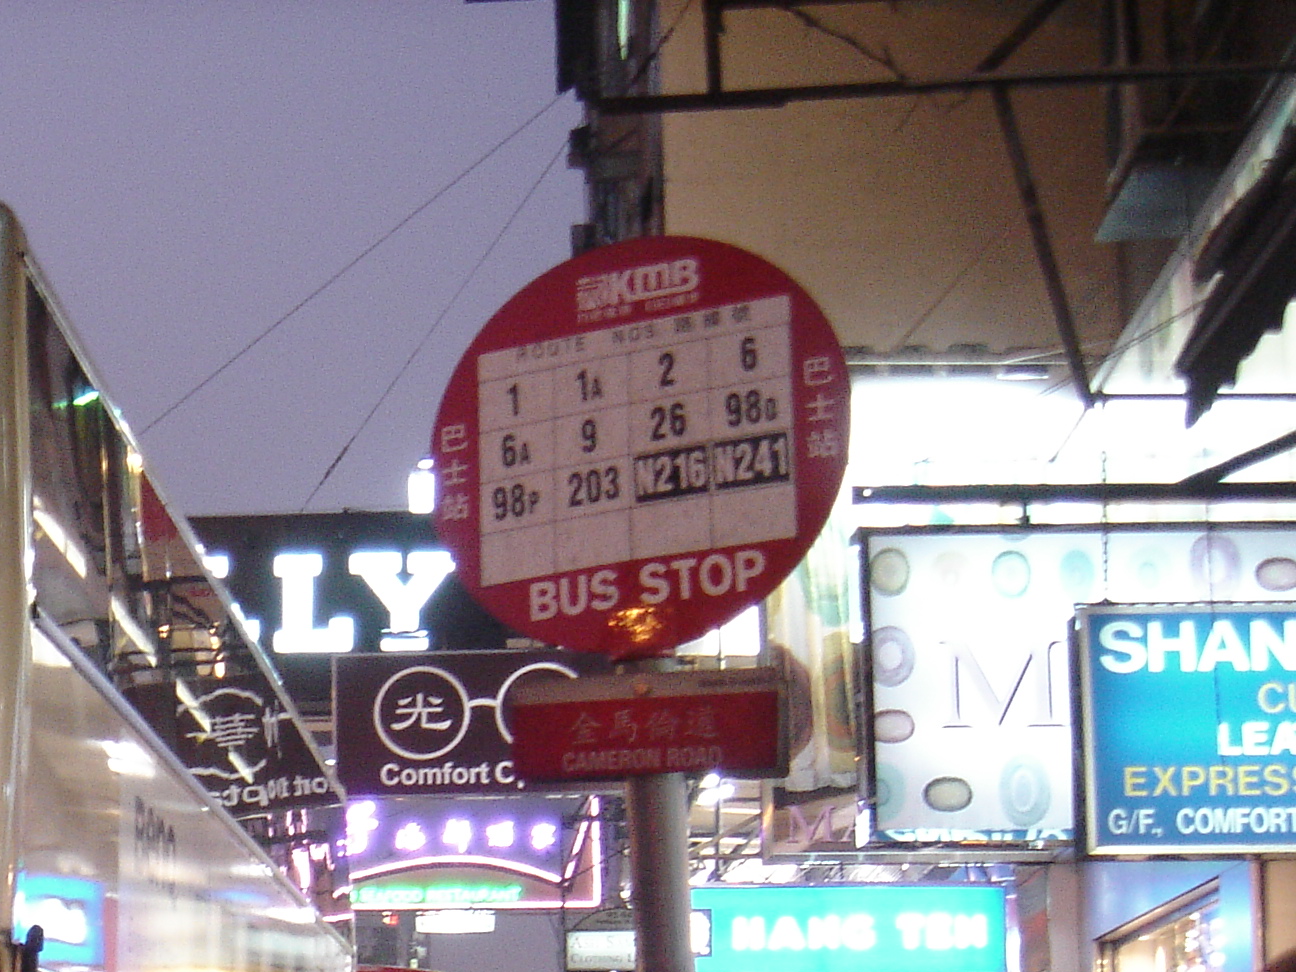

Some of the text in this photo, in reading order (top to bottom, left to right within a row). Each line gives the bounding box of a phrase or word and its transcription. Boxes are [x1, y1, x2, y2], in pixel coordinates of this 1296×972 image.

[507, 337, 757, 417] 1 1A 2 6
[501, 433, 530, 467] 6A
[580, 419, 597, 453] 9
[650, 402, 687, 442] 26
[492, 436, 788, 521] 98P 203 N216 N241
[204, 553, 456, 653] LY
[529, 549, 767, 622] BUS STOP
[1098, 619, 1296, 674] SHAN
[389, 692, 453, 731] 光
[380, 761, 491, 786] Comfort
[562, 746, 722, 773] CAMERON ROAD
[1123, 764, 1296, 797] EXPRES
[731, 913, 988, 951] HANG TEN
